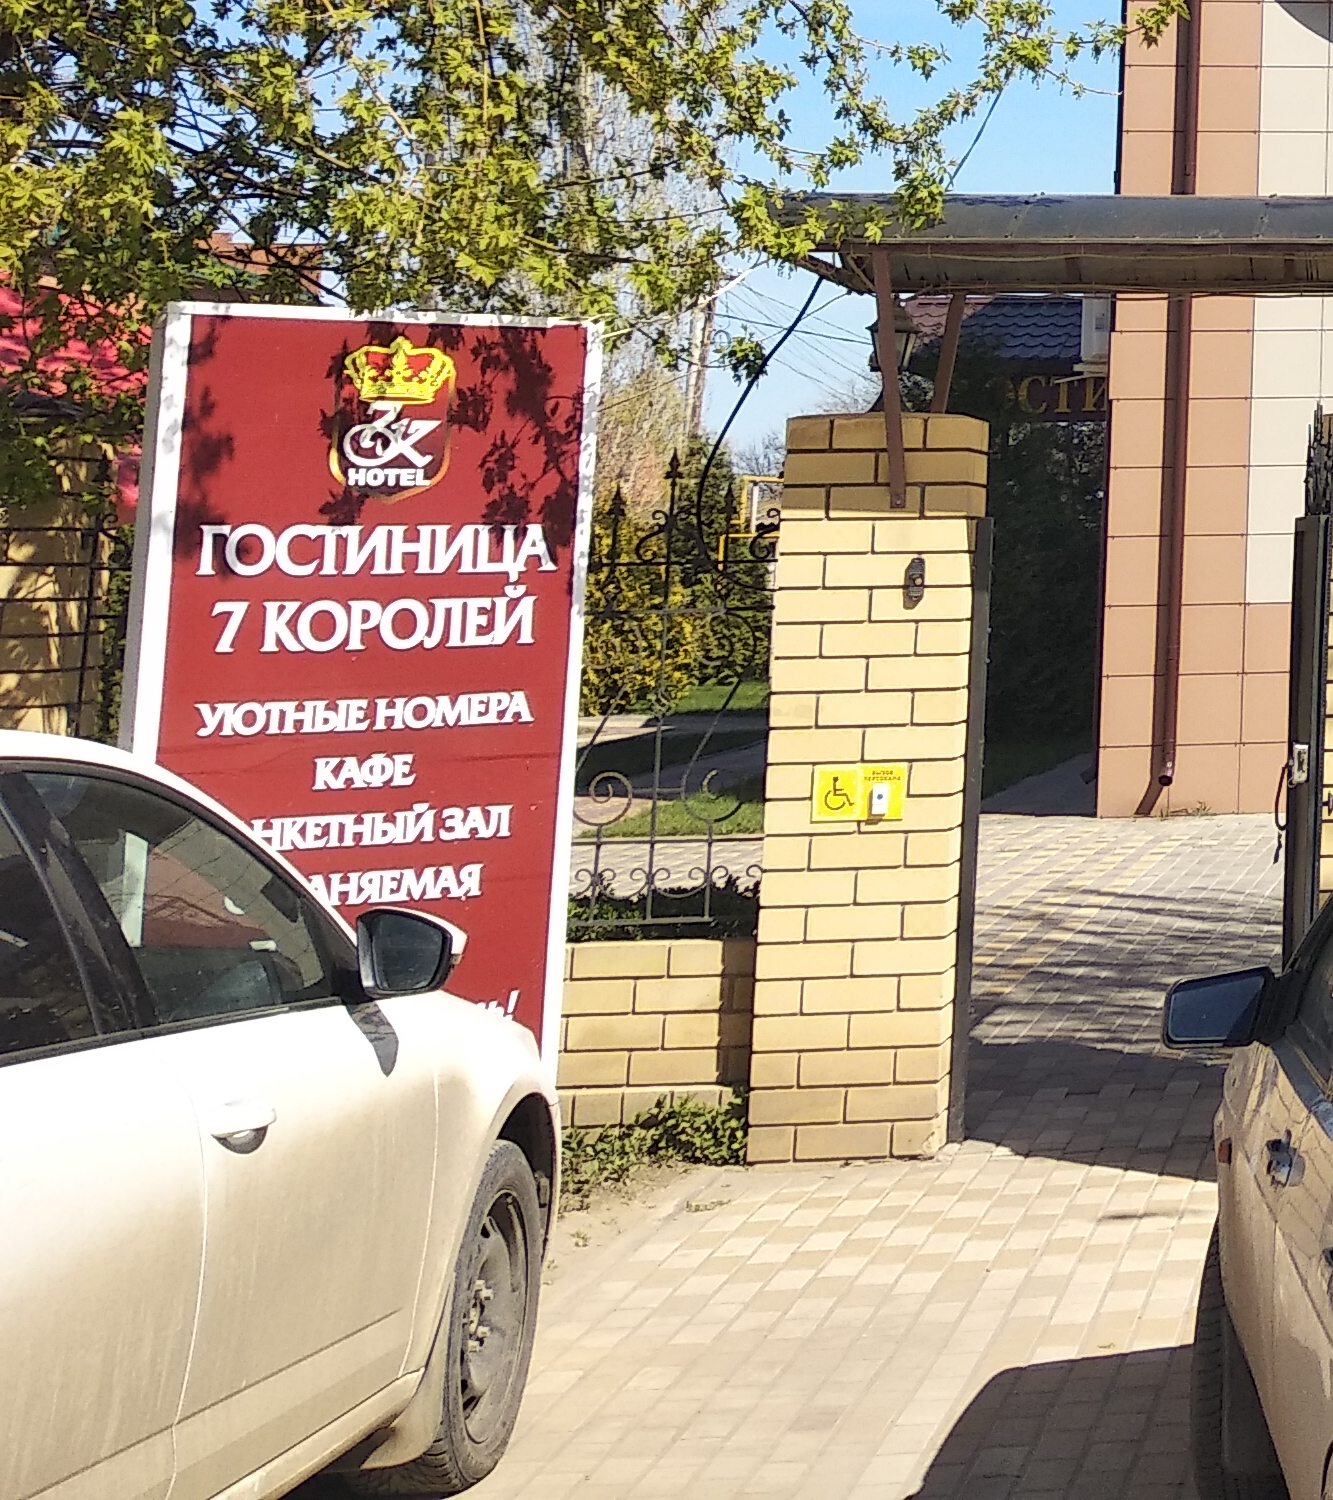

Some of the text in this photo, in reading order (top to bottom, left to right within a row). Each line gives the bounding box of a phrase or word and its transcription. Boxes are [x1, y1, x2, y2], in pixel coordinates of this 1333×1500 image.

[347, 467, 431, 488] HOTEL
[195, 522, 558, 583] ГОСТИНИЦА
[210, 584, 538, 654] 7 КОРОЛЕЙ
[194, 690, 536, 737] УЮТНЫЕ НОМЕРА
[312, 752, 417, 791] КАФЕ
[250, 802, 514, 851] НКЕТНЫЙ ЗАЛ
[306, 862, 485, 906] АНЯЕМАЯ
